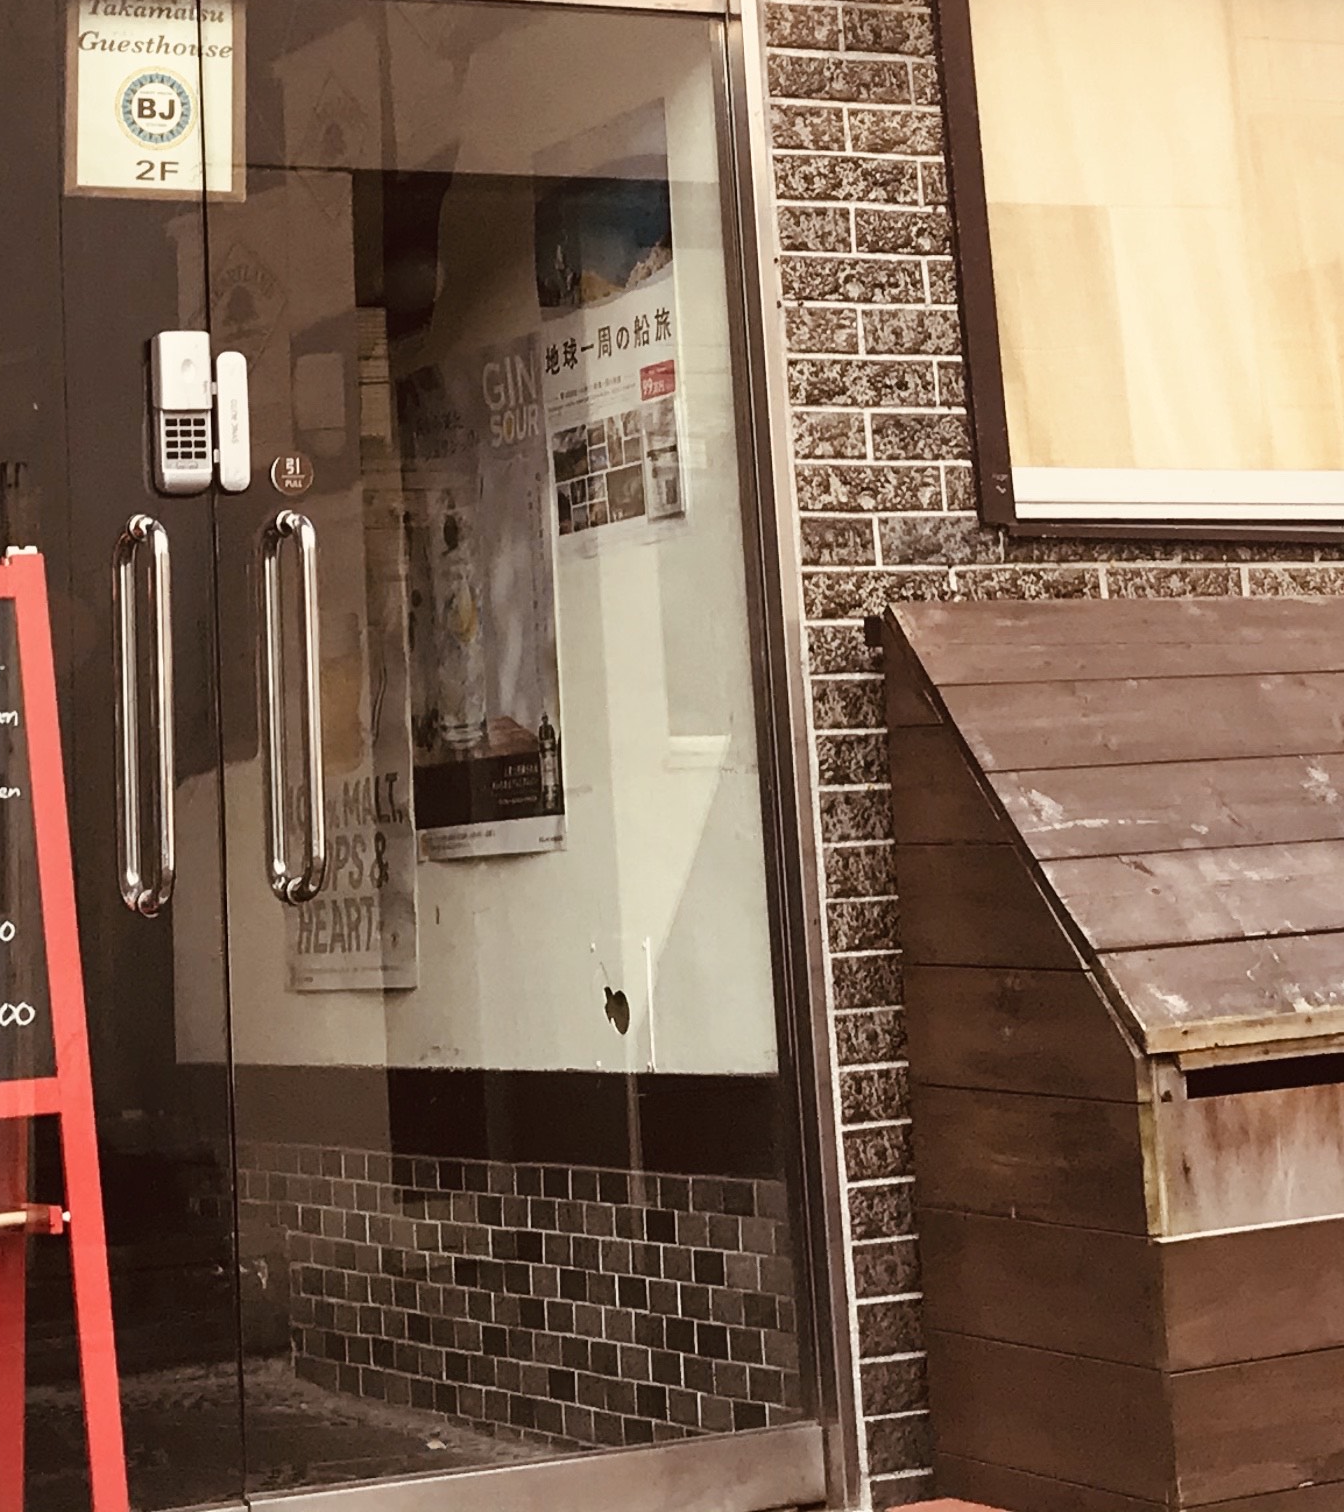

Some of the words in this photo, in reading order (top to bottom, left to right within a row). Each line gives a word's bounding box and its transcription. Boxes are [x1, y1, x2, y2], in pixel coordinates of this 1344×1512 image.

[77, 30, 233, 58] Guesthouse
[137, 97, 175, 120] BJ
[135, 160, 180, 181] 2F
[544, 307, 673, 376] 地球一周の船旅
[482, 351, 538, 410] GIN
[490, 404, 540, 448] SOUR
[285, 457, 301, 476] 引
[285, 479, 303, 489] PULL
